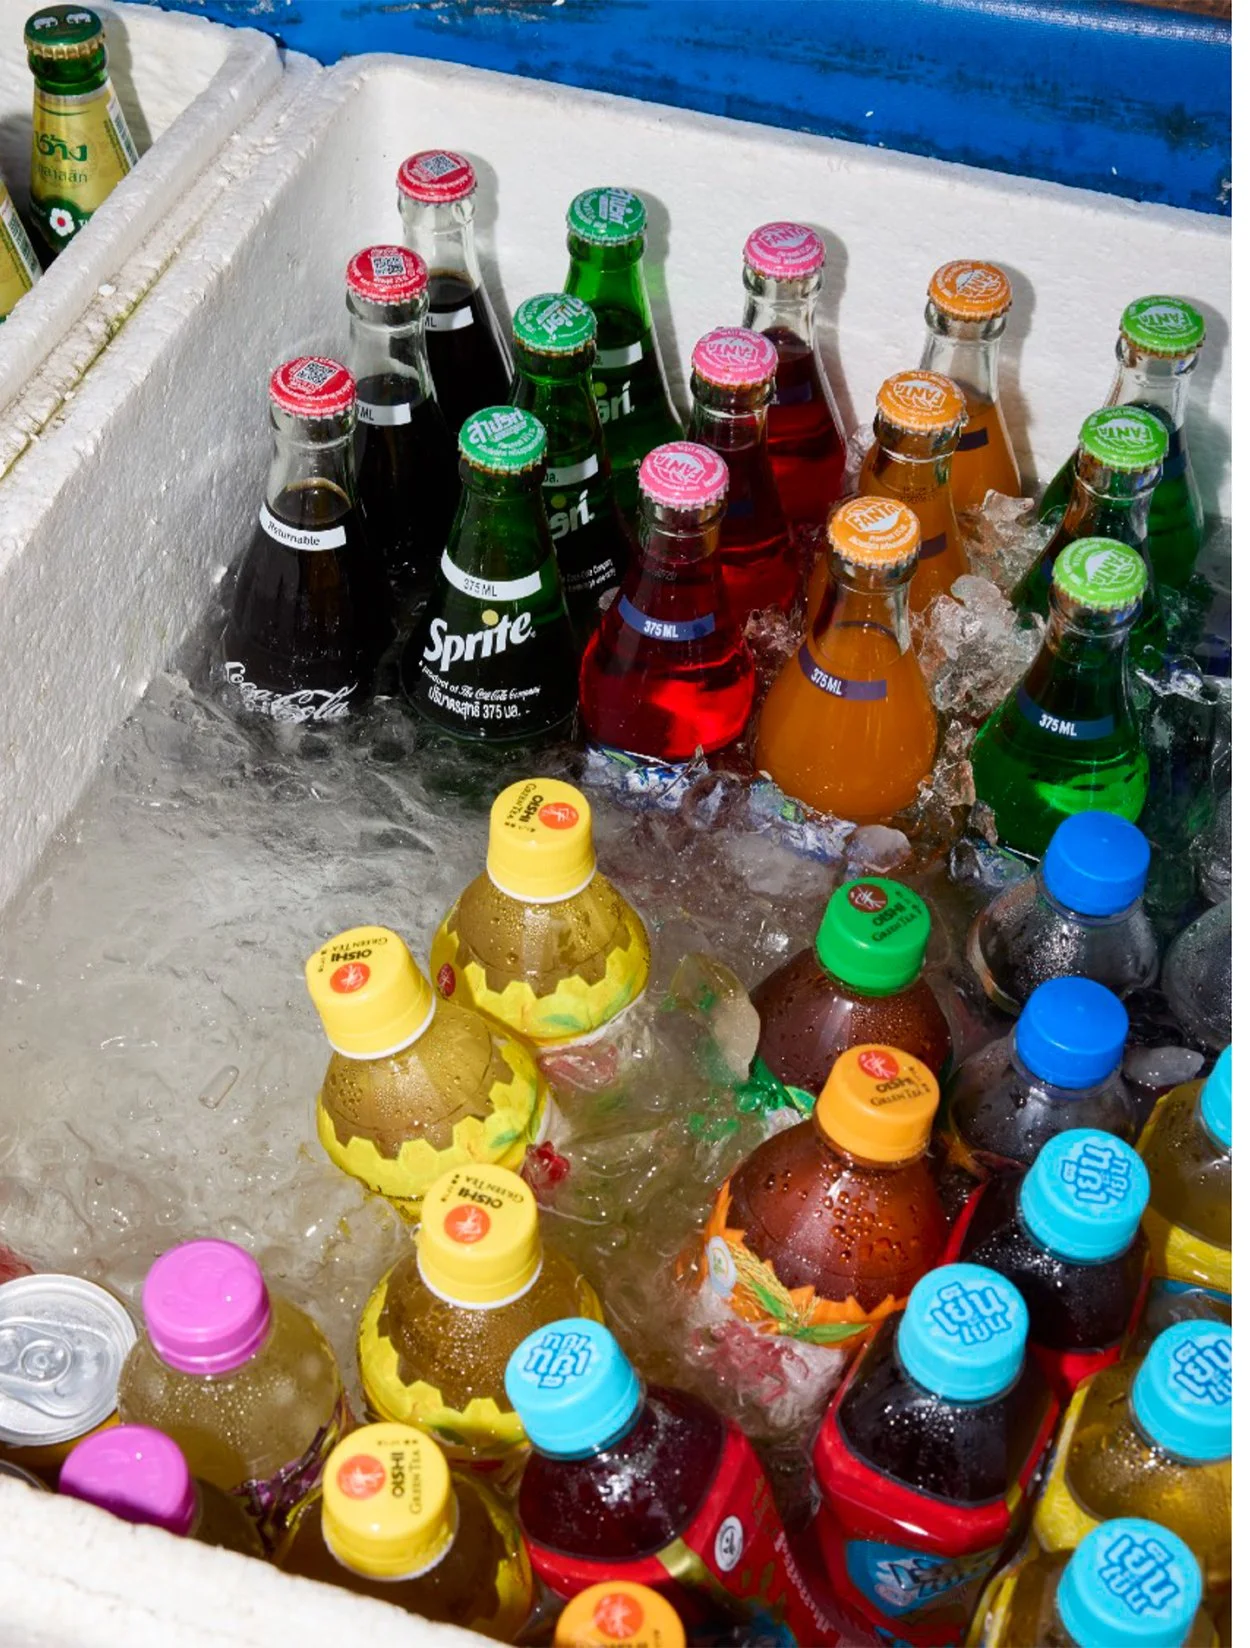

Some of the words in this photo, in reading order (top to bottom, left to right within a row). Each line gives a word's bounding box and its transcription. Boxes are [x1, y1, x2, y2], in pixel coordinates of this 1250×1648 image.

[267, 520, 320, 545] Returnable
[423, 609, 533, 672] Sprite
[482, 703, 502, 719] 375
[519, 794, 543, 822] OISHI
[331, 949, 372, 962] OISHI
[458, 1187, 503, 1209] OISHI
[391, 1451, 405, 1499] OISHI
